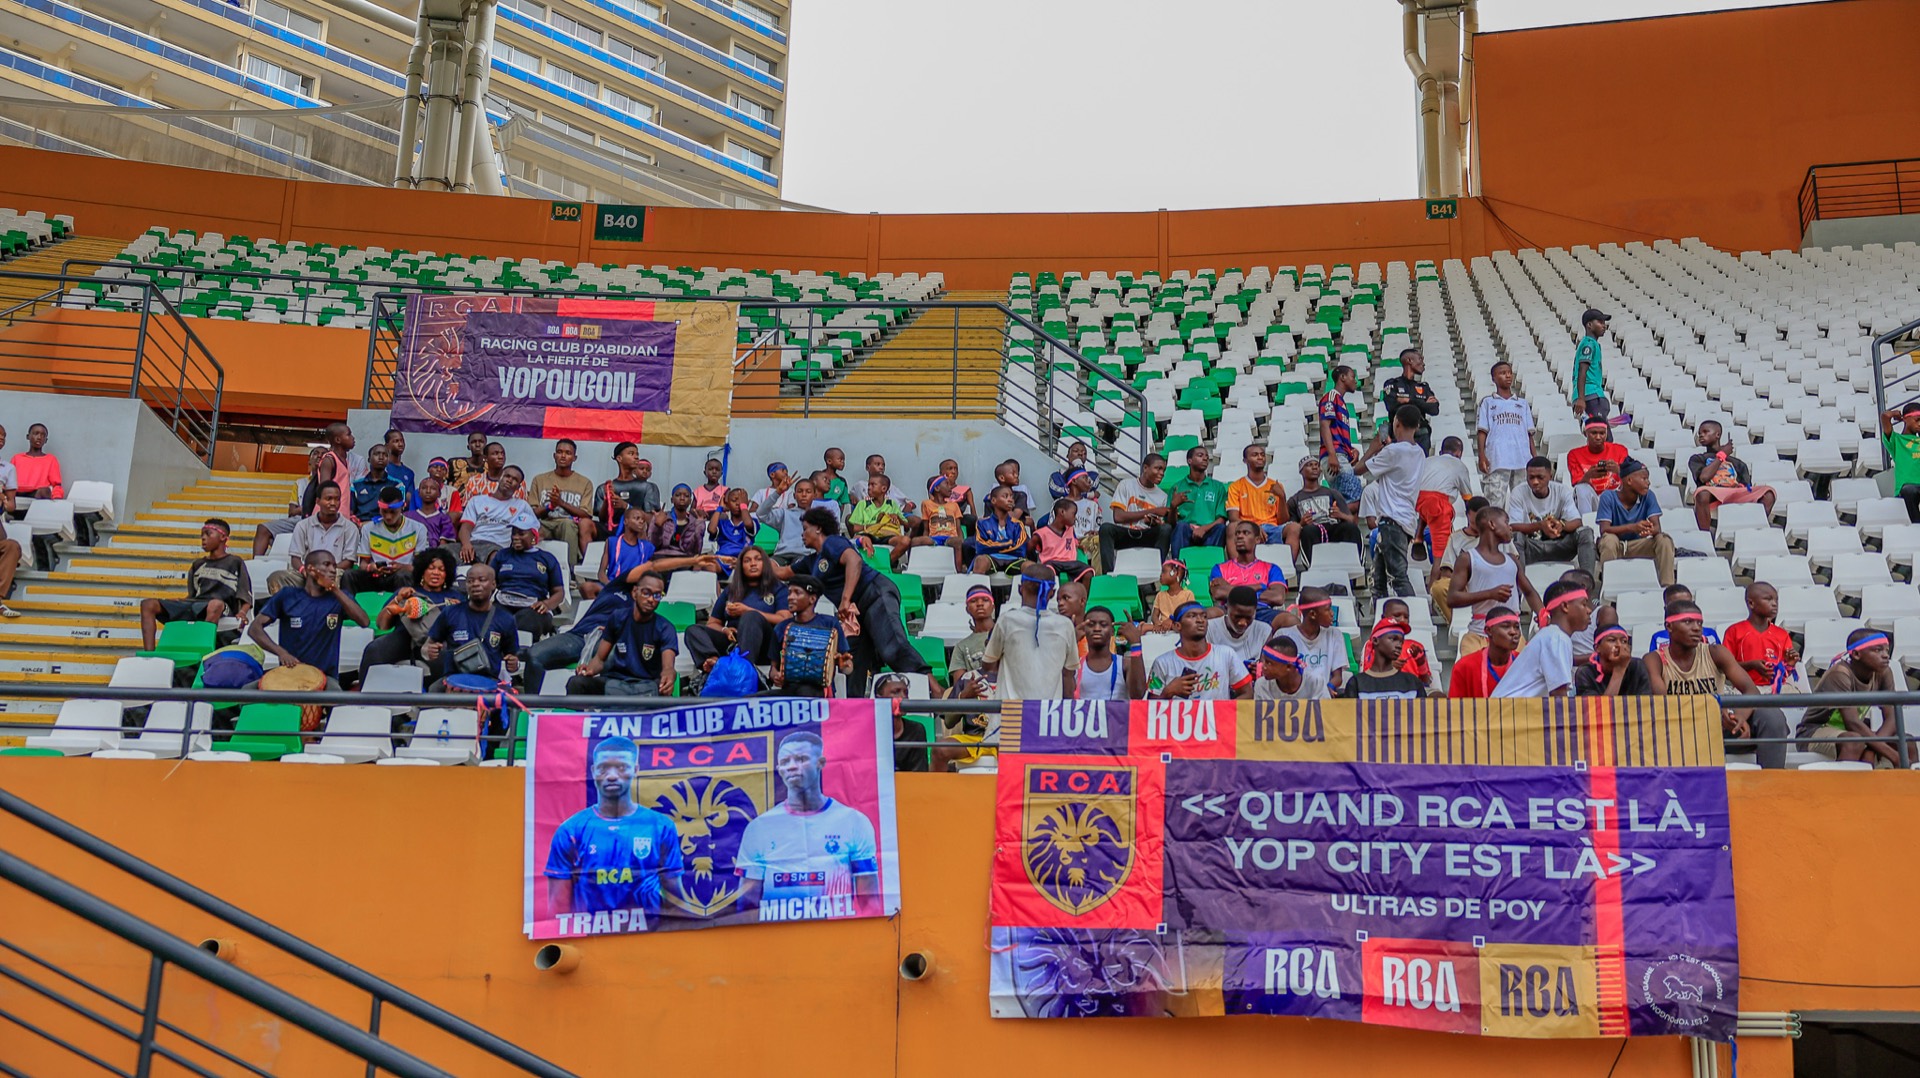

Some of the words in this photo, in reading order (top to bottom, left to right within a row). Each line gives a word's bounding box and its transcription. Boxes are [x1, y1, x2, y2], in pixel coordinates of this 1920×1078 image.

[555, 206, 578, 217] B40
[603, 214, 638, 229] B40
[1431, 204, 1452, 215] B41
[480, 337, 538, 352] RACING
[541, 340, 580, 355] CLUB
[584, 343, 658, 357] D'ABIDJAN
[527, 354, 545, 364] LA
[547, 354, 589, 367] FIERTÉ
[592, 357, 609, 367] DE
[497, 366, 637, 403] YOPOUGON
[582, 716, 642, 739] FAN
[651, 712, 724, 738] CLUB
[728, 699, 830, 730] ABOBO
[1038, 699, 1109, 739] RCA
[1146, 700, 1218, 741] RCA
[1253, 700, 1326, 742] RCA
[651, 742, 753, 767] RCA
[1039, 771, 1121, 793] RCA
[1238, 791, 1404, 830] QUAND
[1418, 795, 1515, 830] RCA
[1528, 798, 1615, 831] EST
[1628, 789, 1706, 839] LÀ,
[1224, 837, 1316, 871] YOP
[1327, 838, 1432, 875] CITY
[1445, 843, 1531, 877] EST
[597, 868, 634, 885] RCA
[774, 872, 824, 883] COSMOS
[758, 894, 856, 922] MICKAEL
[1330, 893, 1438, 917] ULTRAS
[1445, 899, 1481, 919] DE
[1488, 900, 1546, 921] POY
[555, 908, 648, 935] TRAPA
[1264, 947, 1342, 1000] RCA
[1382, 956, 1461, 1013] RCA
[1500, 963, 1580, 1018] RCA
